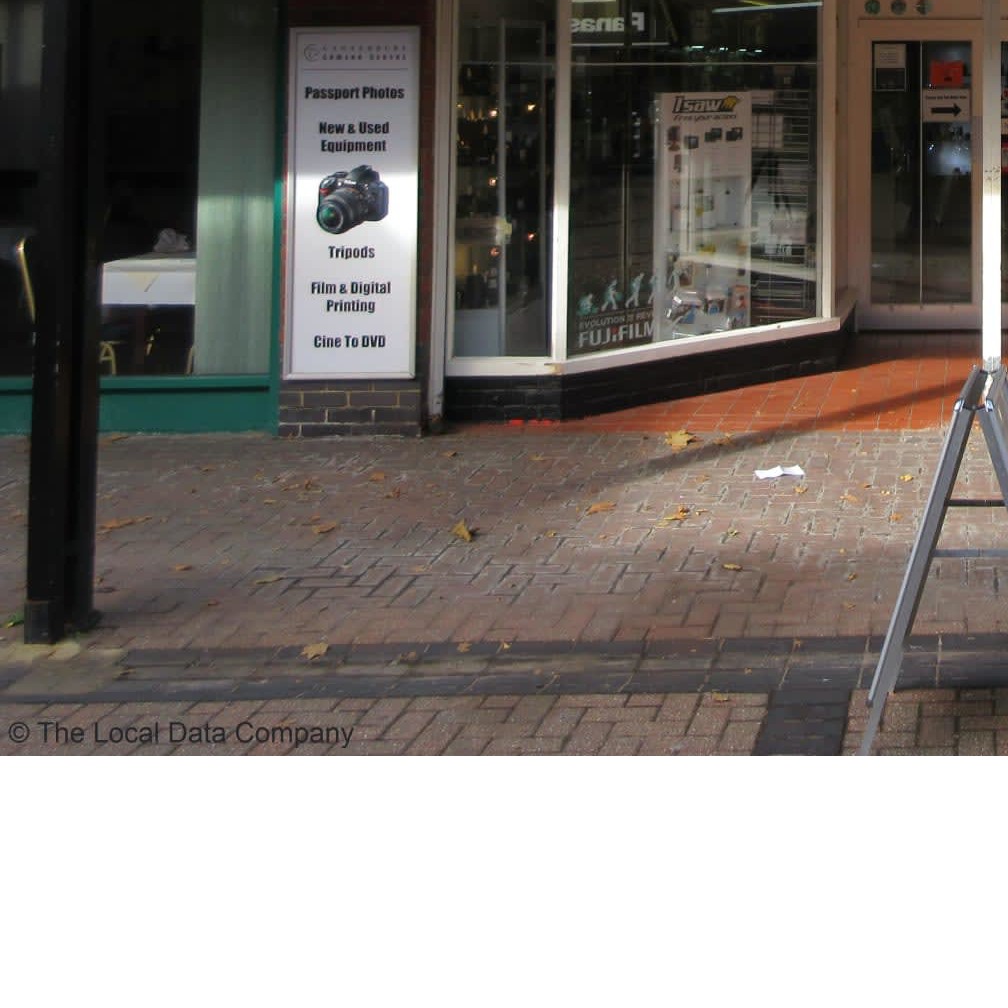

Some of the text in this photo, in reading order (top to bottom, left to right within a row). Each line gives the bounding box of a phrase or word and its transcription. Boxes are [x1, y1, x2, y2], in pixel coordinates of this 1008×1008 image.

[304, 86, 405, 101] Passport Photos
[319, 121, 390, 134] New & Used
[320, 139, 387, 153] Equipment
[328, 245, 375, 260] Tripods
[311, 281, 391, 295] Film & Digital
[326, 299, 376, 313] Printing
[313, 335, 386, 348] Cine To DVD
